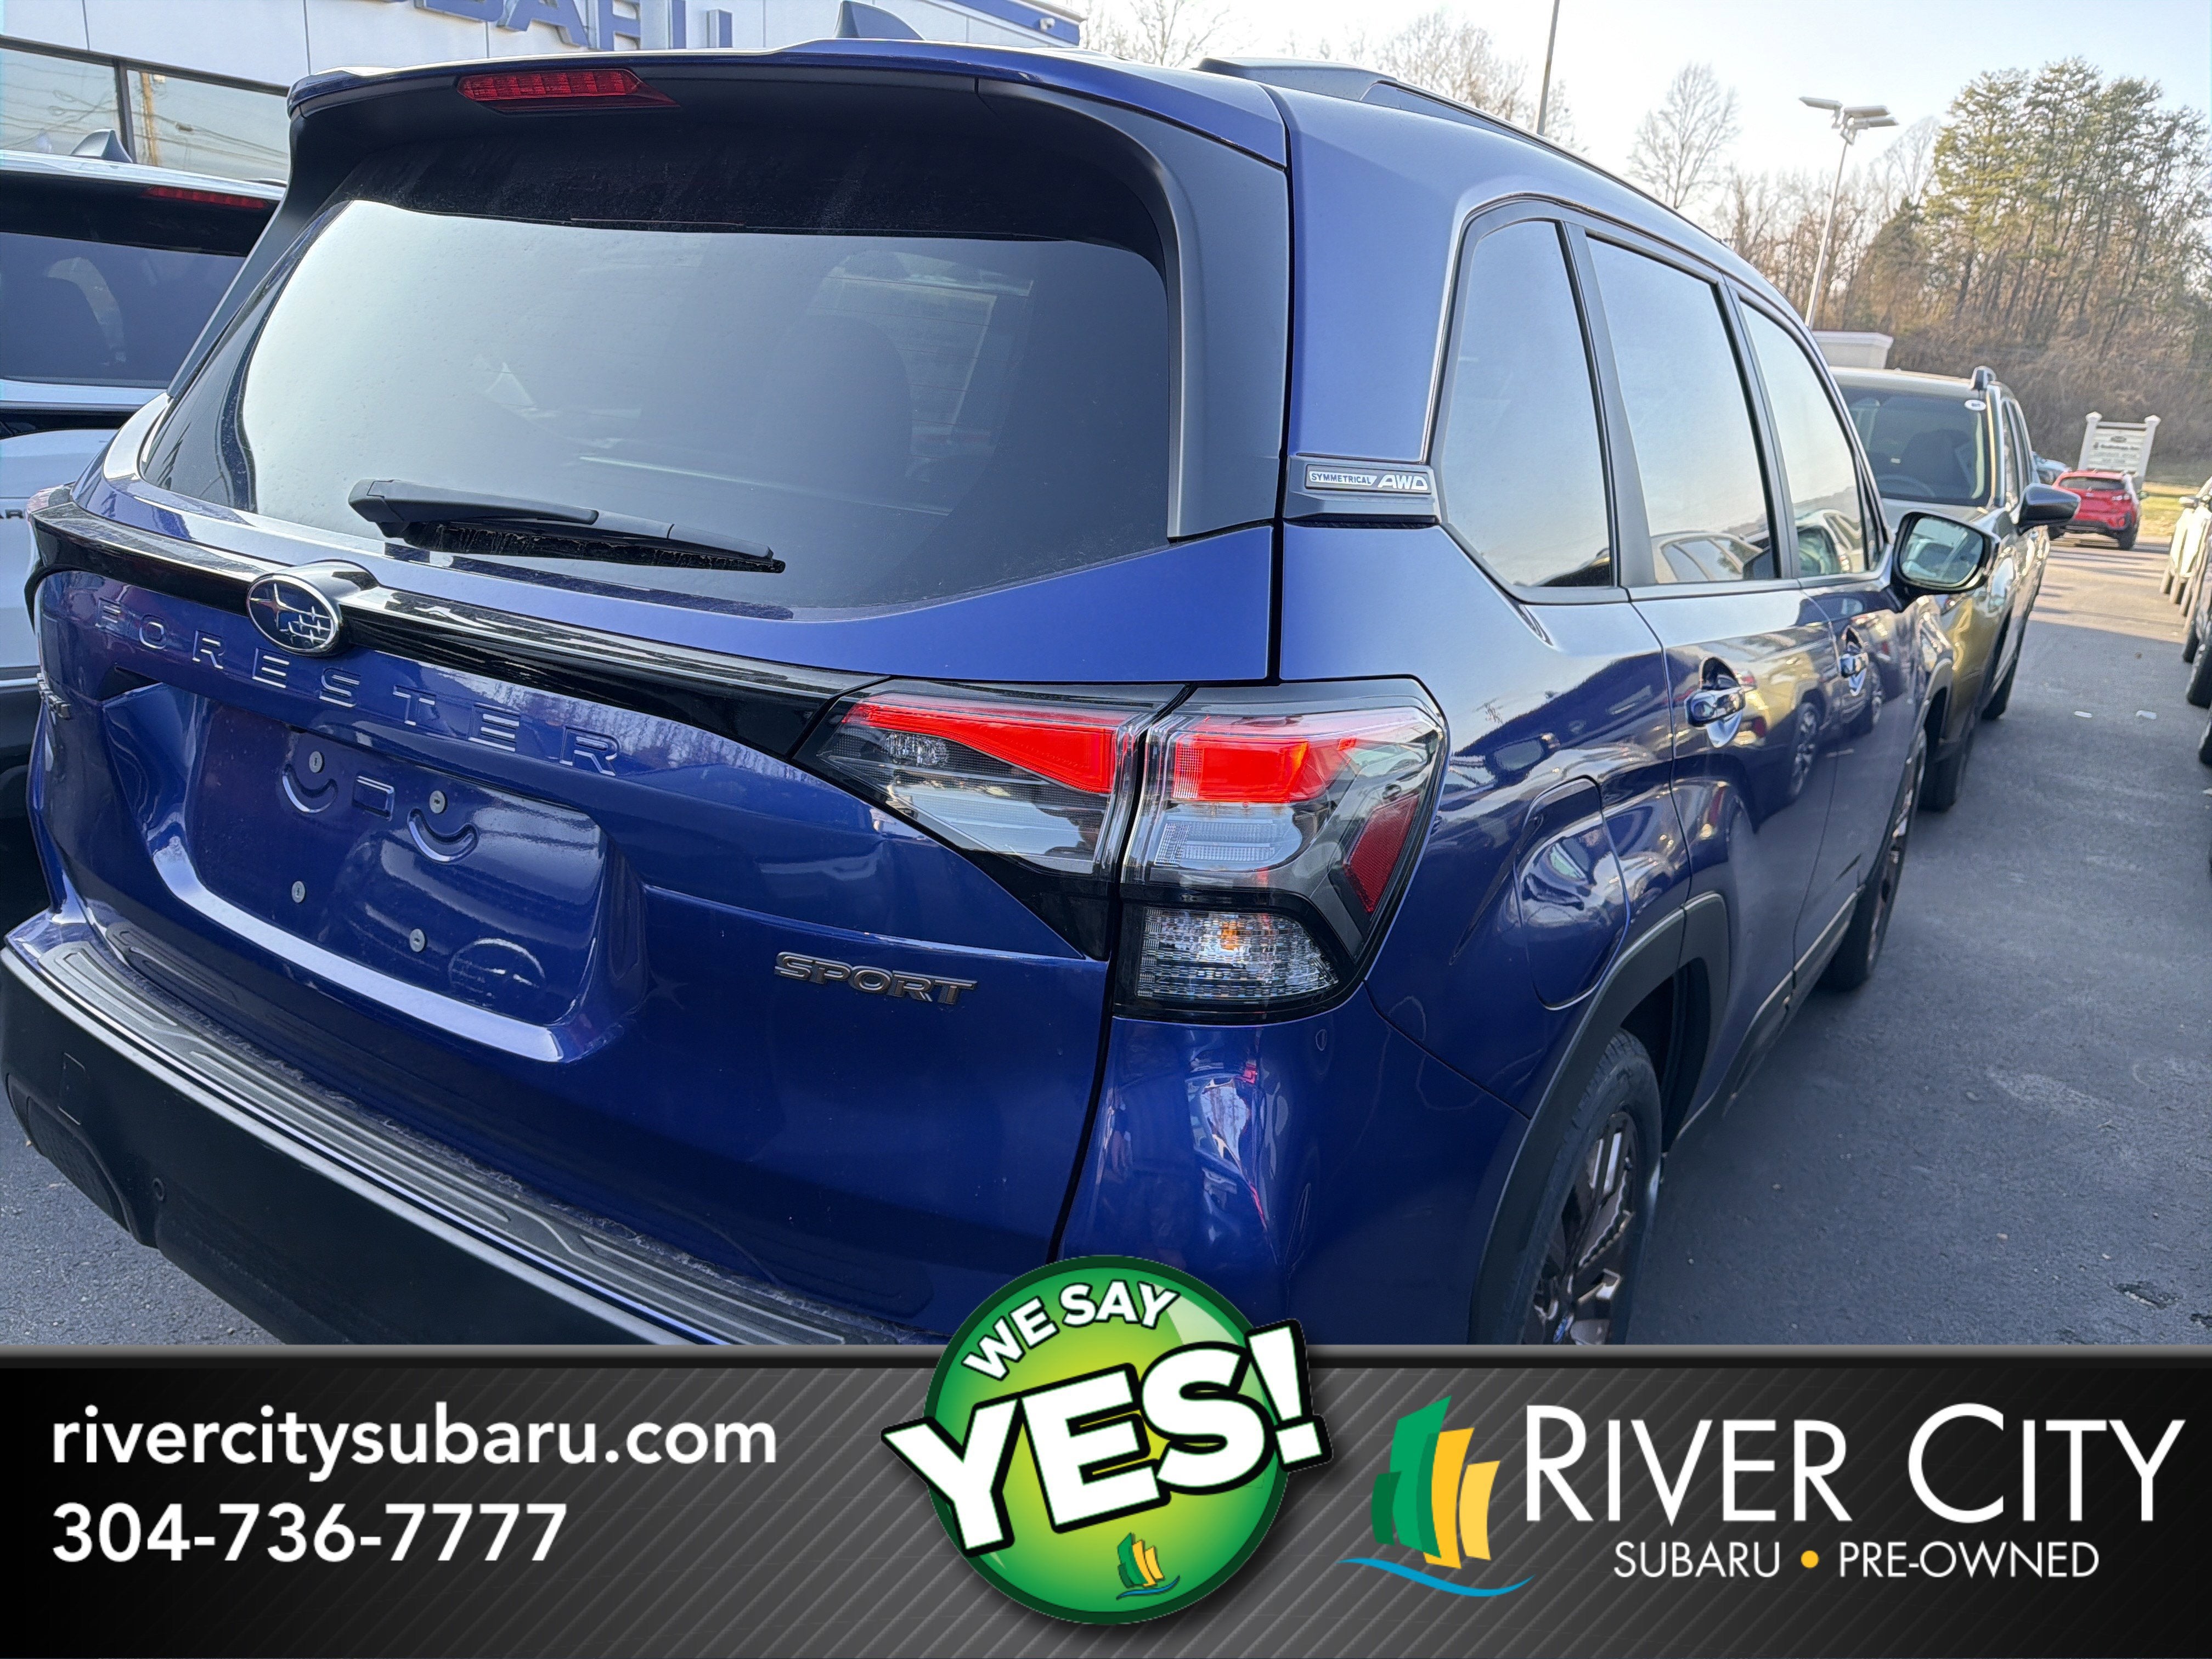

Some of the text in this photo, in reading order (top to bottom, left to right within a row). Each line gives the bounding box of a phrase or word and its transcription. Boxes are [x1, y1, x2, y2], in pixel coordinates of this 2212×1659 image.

[1310, 472, 1428, 491] SYMMETRICAL AWD
[95, 597, 620, 776] FORESTER
[774, 951, 978, 1005] SPORT
